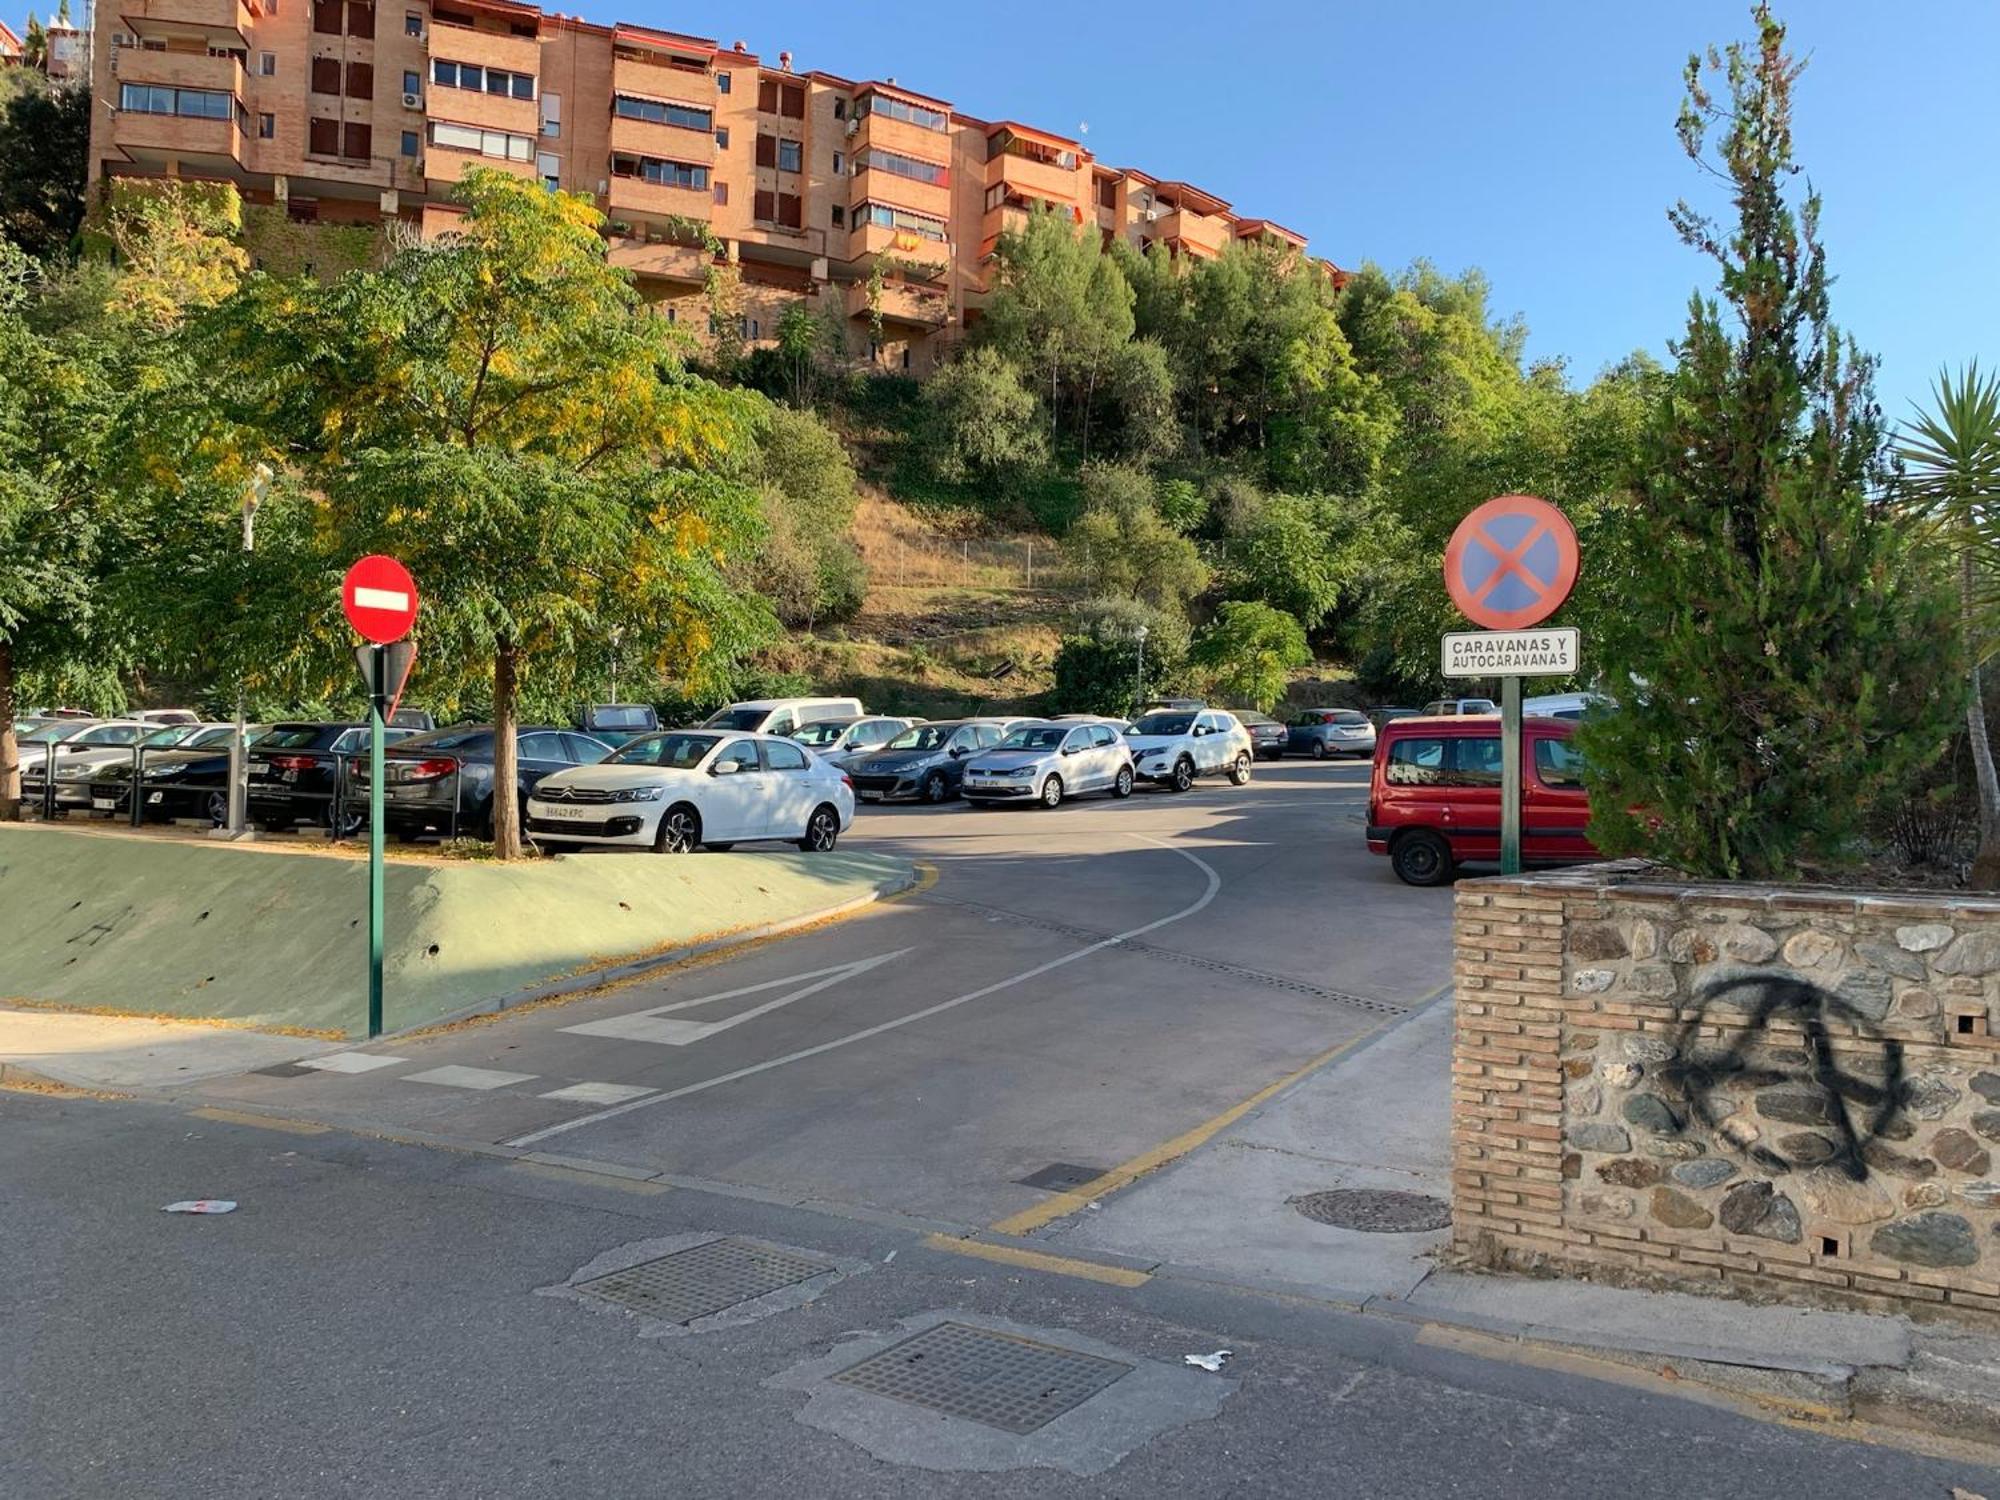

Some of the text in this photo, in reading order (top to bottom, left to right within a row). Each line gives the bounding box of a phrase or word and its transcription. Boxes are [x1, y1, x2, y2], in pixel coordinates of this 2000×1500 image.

[1452, 637, 1567, 654] CARAVANAS Y
[1452, 653, 1568, 668] AUTOCARAVANAS
